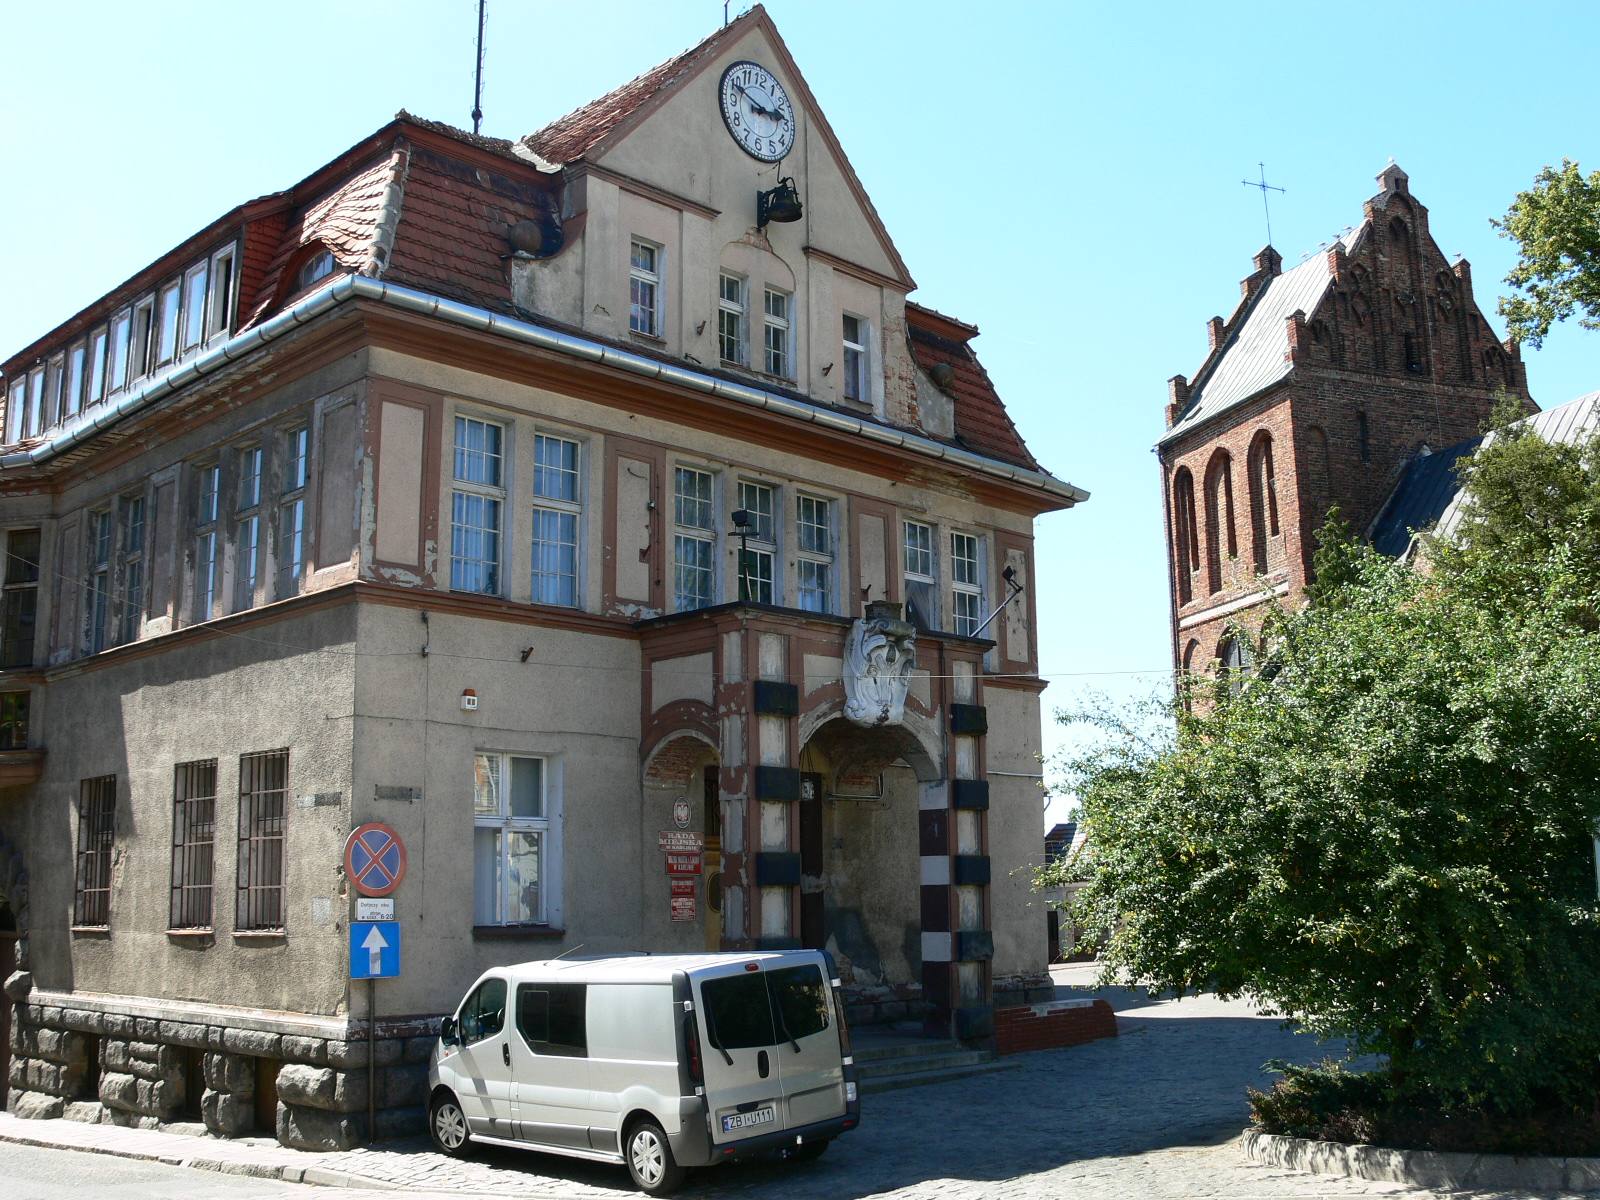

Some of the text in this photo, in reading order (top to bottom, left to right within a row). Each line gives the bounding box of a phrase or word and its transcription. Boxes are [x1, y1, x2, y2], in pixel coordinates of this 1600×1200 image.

[742, 69, 751, 86] 11
[755, 72, 767, 90] 12
[770, 84, 775, 97] 1
[730, 93, 737, 107] 9
[778, 96, 785, 111] 2
[733, 111, 741, 126] 8
[783, 118, 789, 132] 3
[743, 128, 750, 142] 7
[778, 133, 785, 147] 4
[755, 138, 762, 151] 6
[769, 140, 776, 154] 5
[667, 832, 695, 840] RADA
[729, 1109, 771, 1129] ZBI U111
